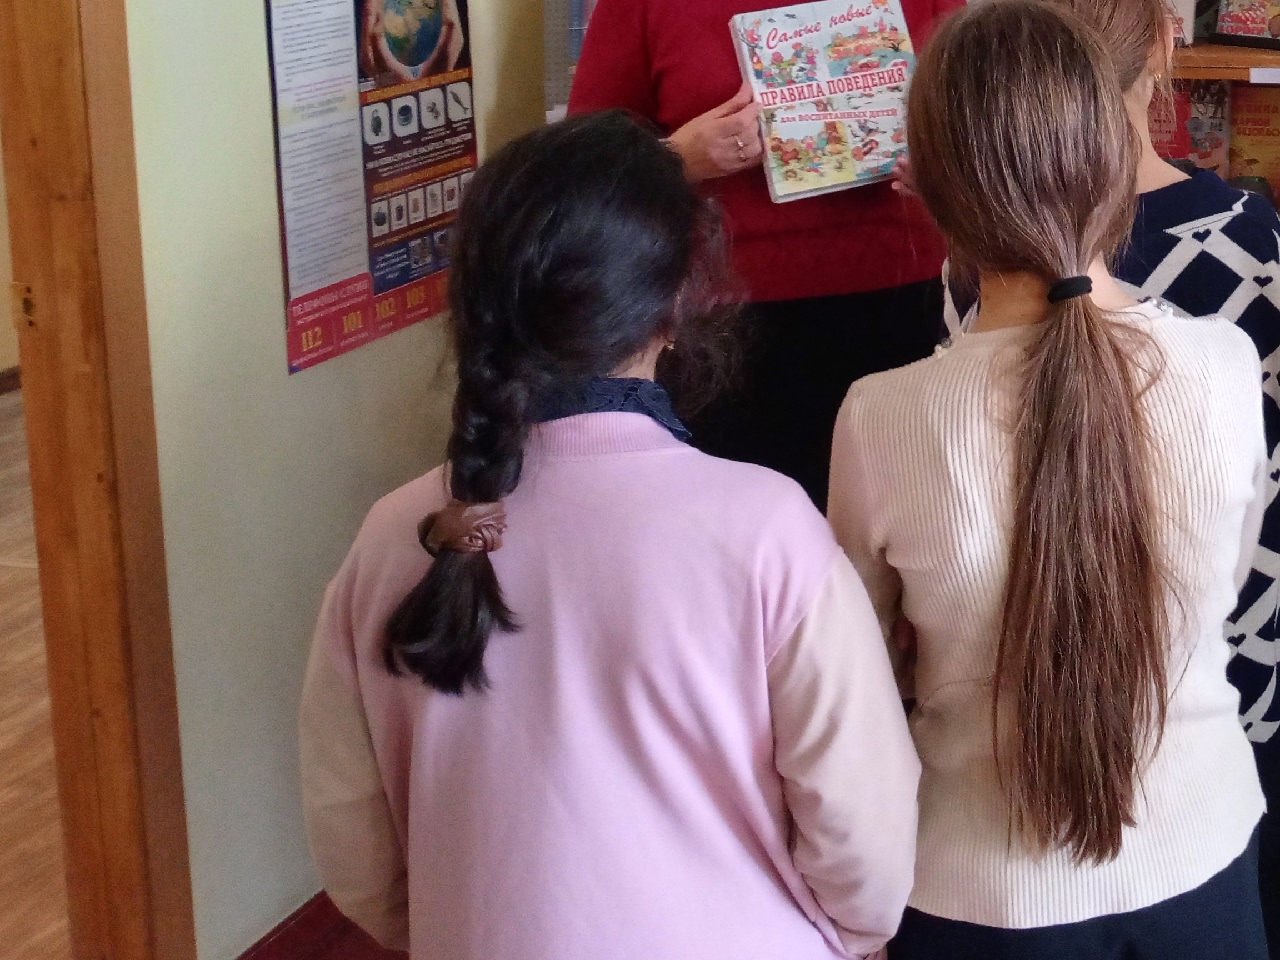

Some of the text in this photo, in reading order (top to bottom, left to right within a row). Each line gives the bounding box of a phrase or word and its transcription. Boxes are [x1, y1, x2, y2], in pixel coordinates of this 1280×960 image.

[766, 3, 874, 50] Самые новые
[760, 67, 907, 107] ПРАВИЛА ПОВЕДЕНИЯ
[798, 109, 868, 122] ВОСПИТАННЫХ
[868, 107, 898, 118] ДЕТЕЙ
[375, 297, 398, 319] 102
[301, 326, 323, 351] 112
